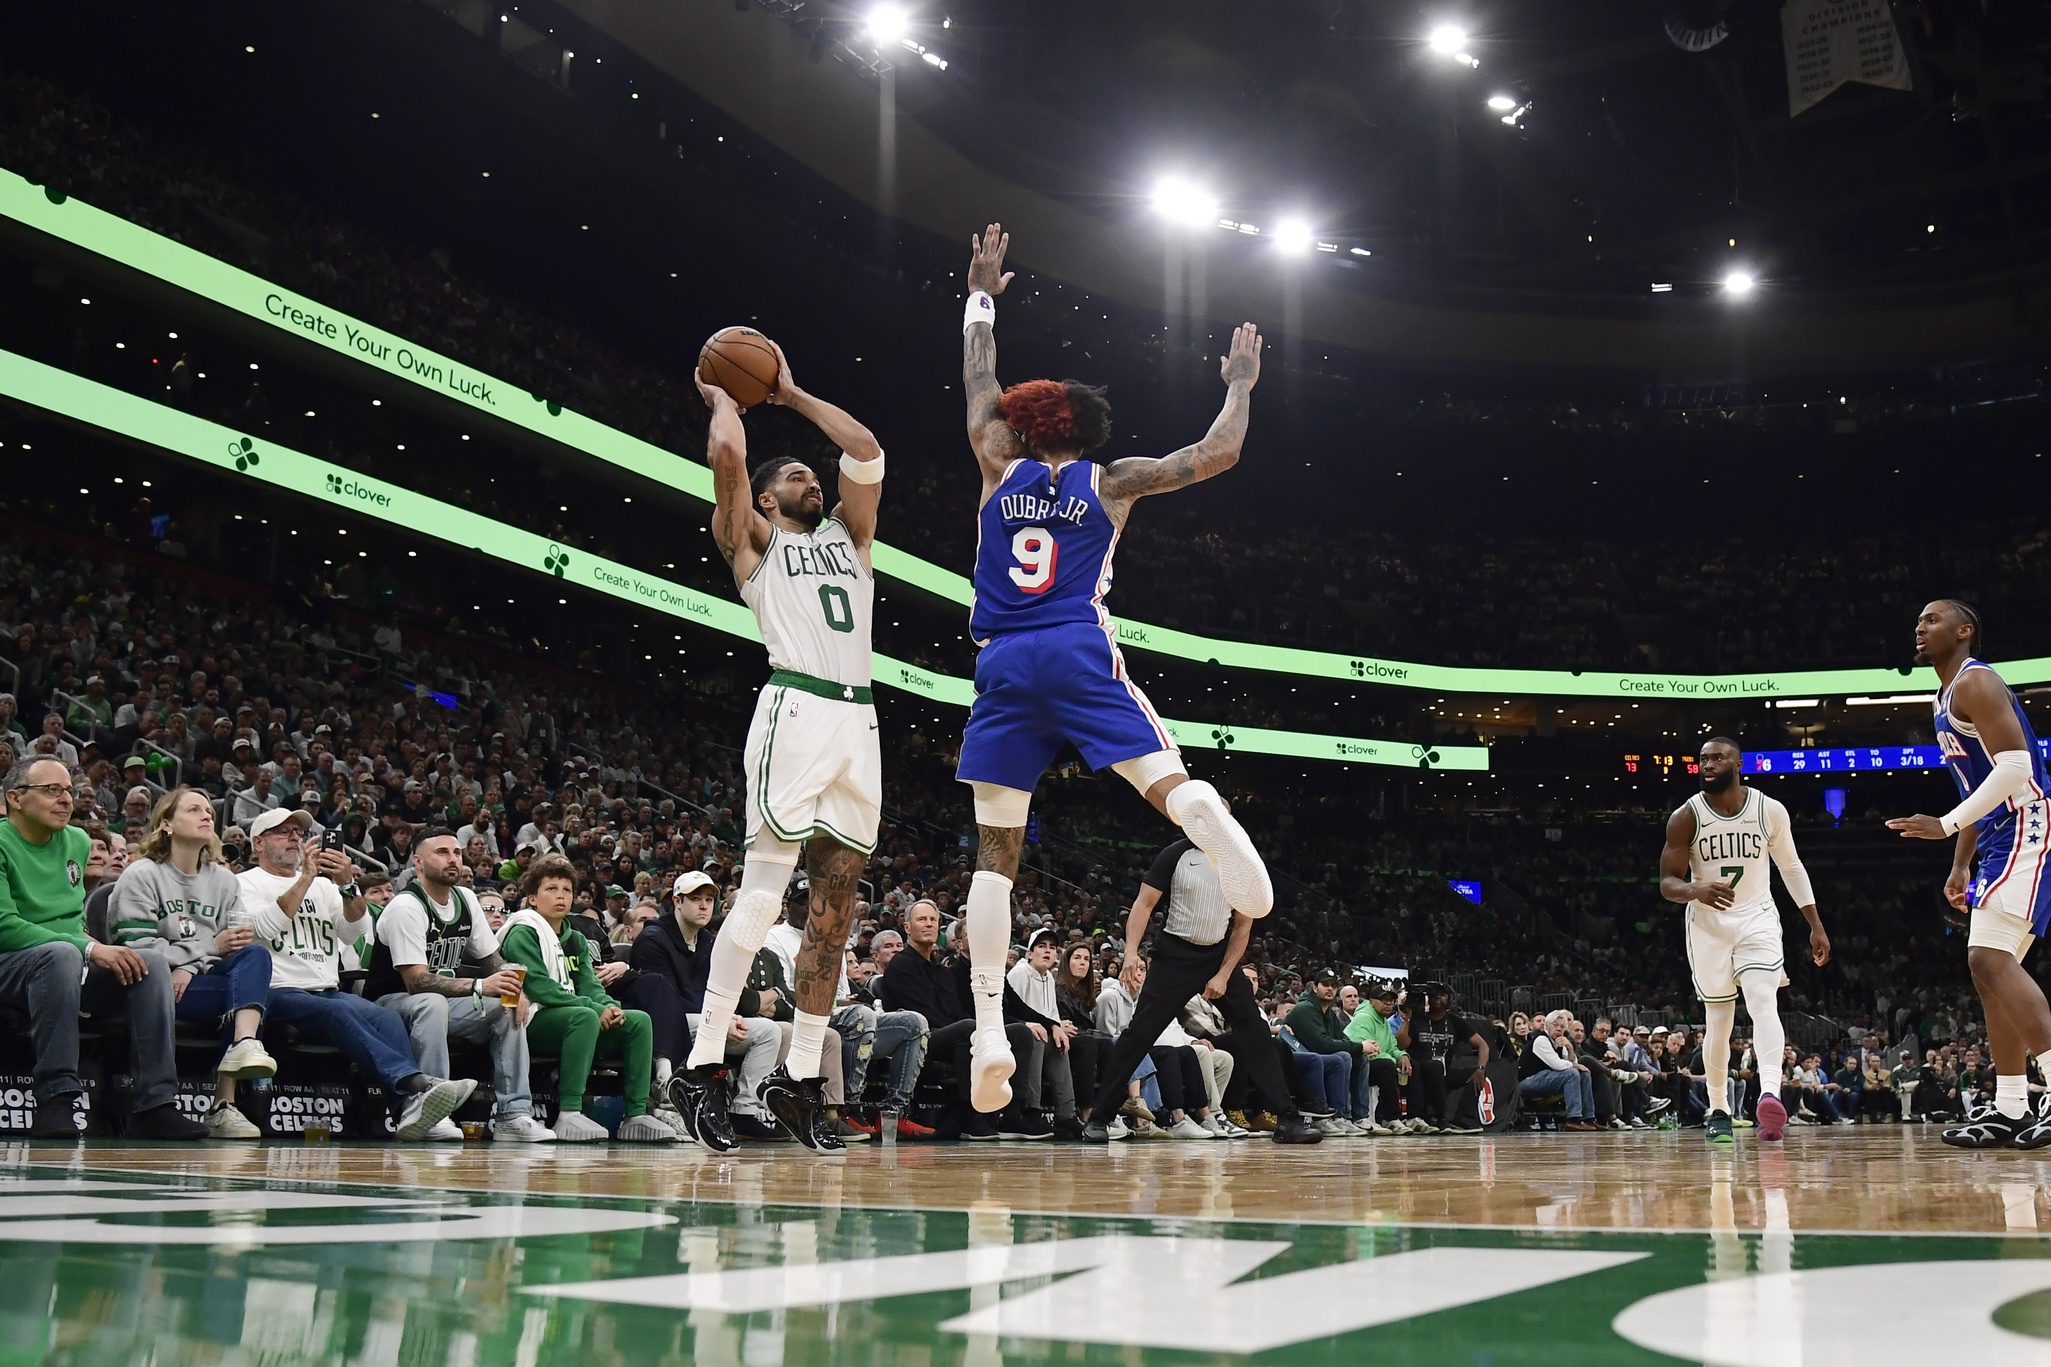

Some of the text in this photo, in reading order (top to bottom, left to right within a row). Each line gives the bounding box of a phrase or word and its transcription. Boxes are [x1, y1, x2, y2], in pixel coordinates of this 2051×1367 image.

[265, 294, 496, 405] Create Your Own Luck.
[344, 481, 392, 508] clover
[1008, 526, 1059, 595] 9
[594, 567, 713, 617] Create Your Own Luck.
[817, 584, 855, 633] 0
[1119, 623, 1150, 644] Luck.
[1366, 662, 1408, 680] clover
[909, 673, 935, 690] clover
[1619, 678, 1780, 694] Create Your Own Luck.
[1347, 744, 1378, 756] clover
[1625, 762, 1637, 773] 73
[1653, 755, 1674, 766] 7:13
[1687, 764, 1699, 774] 58
[1793, 759, 1806, 770] 29
[1820, 758, 1831, 769] 11
[1848, 757, 1856, 768] 2
[1870, 757, 1883, 767] 10
[1900, 755, 1924, 767] 3/18
[1698, 832, 1762, 862] CELTICS
[1720, 865, 1744, 890] 7
[283, 1085, 302, 1093] ROW
[269, 1114, 344, 1133] CELTS
